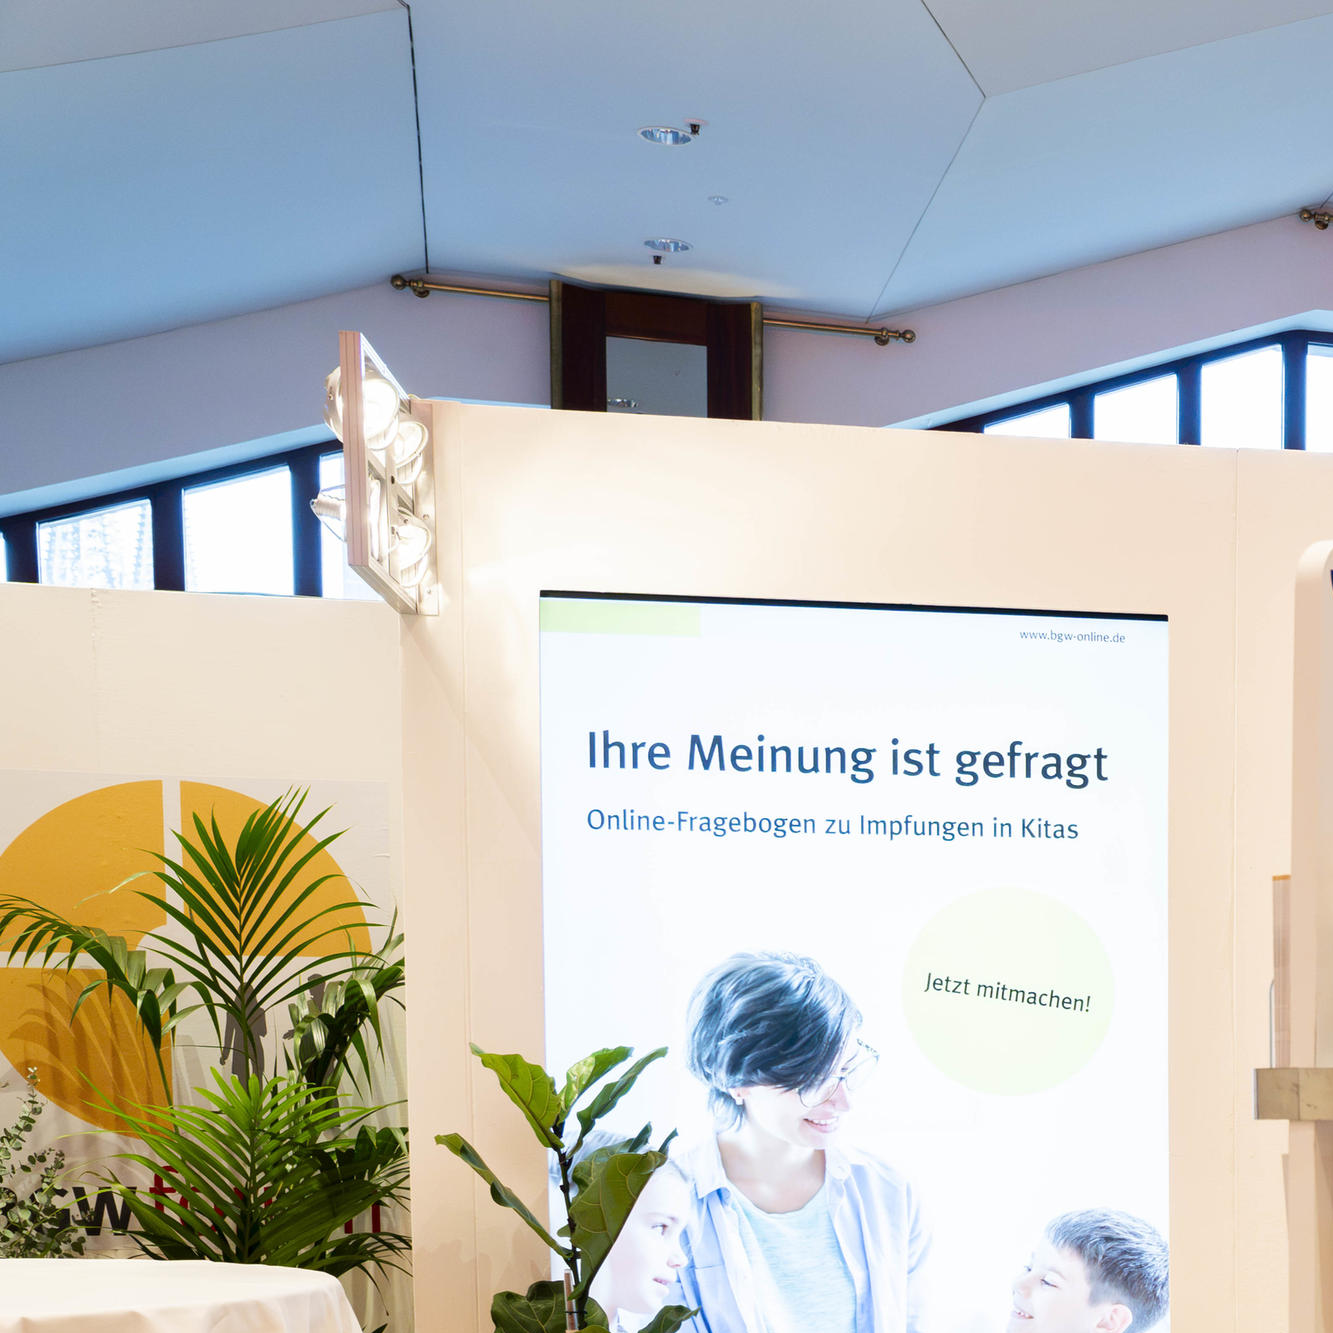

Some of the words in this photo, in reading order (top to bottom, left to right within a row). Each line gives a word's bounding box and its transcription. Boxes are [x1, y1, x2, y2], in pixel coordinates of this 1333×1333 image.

[1019, 629, 1126, 643] www.bgw-online.de
[588, 731, 672, 771] Ihre
[688, 734, 877, 784] Meinung
[891, 738, 941, 777] ist
[956, 741, 1109, 789] gefragt
[587, 808, 816, 838] Online-Fragebogen
[825, 816, 851, 835] zu
[859, 815, 984, 842] Impfungen
[993, 819, 1013, 838] in
[1021, 819, 1079, 840] Kitas
[925, 972, 970, 996] Jetzt
[977, 981, 1091, 1013] mitmachen!
